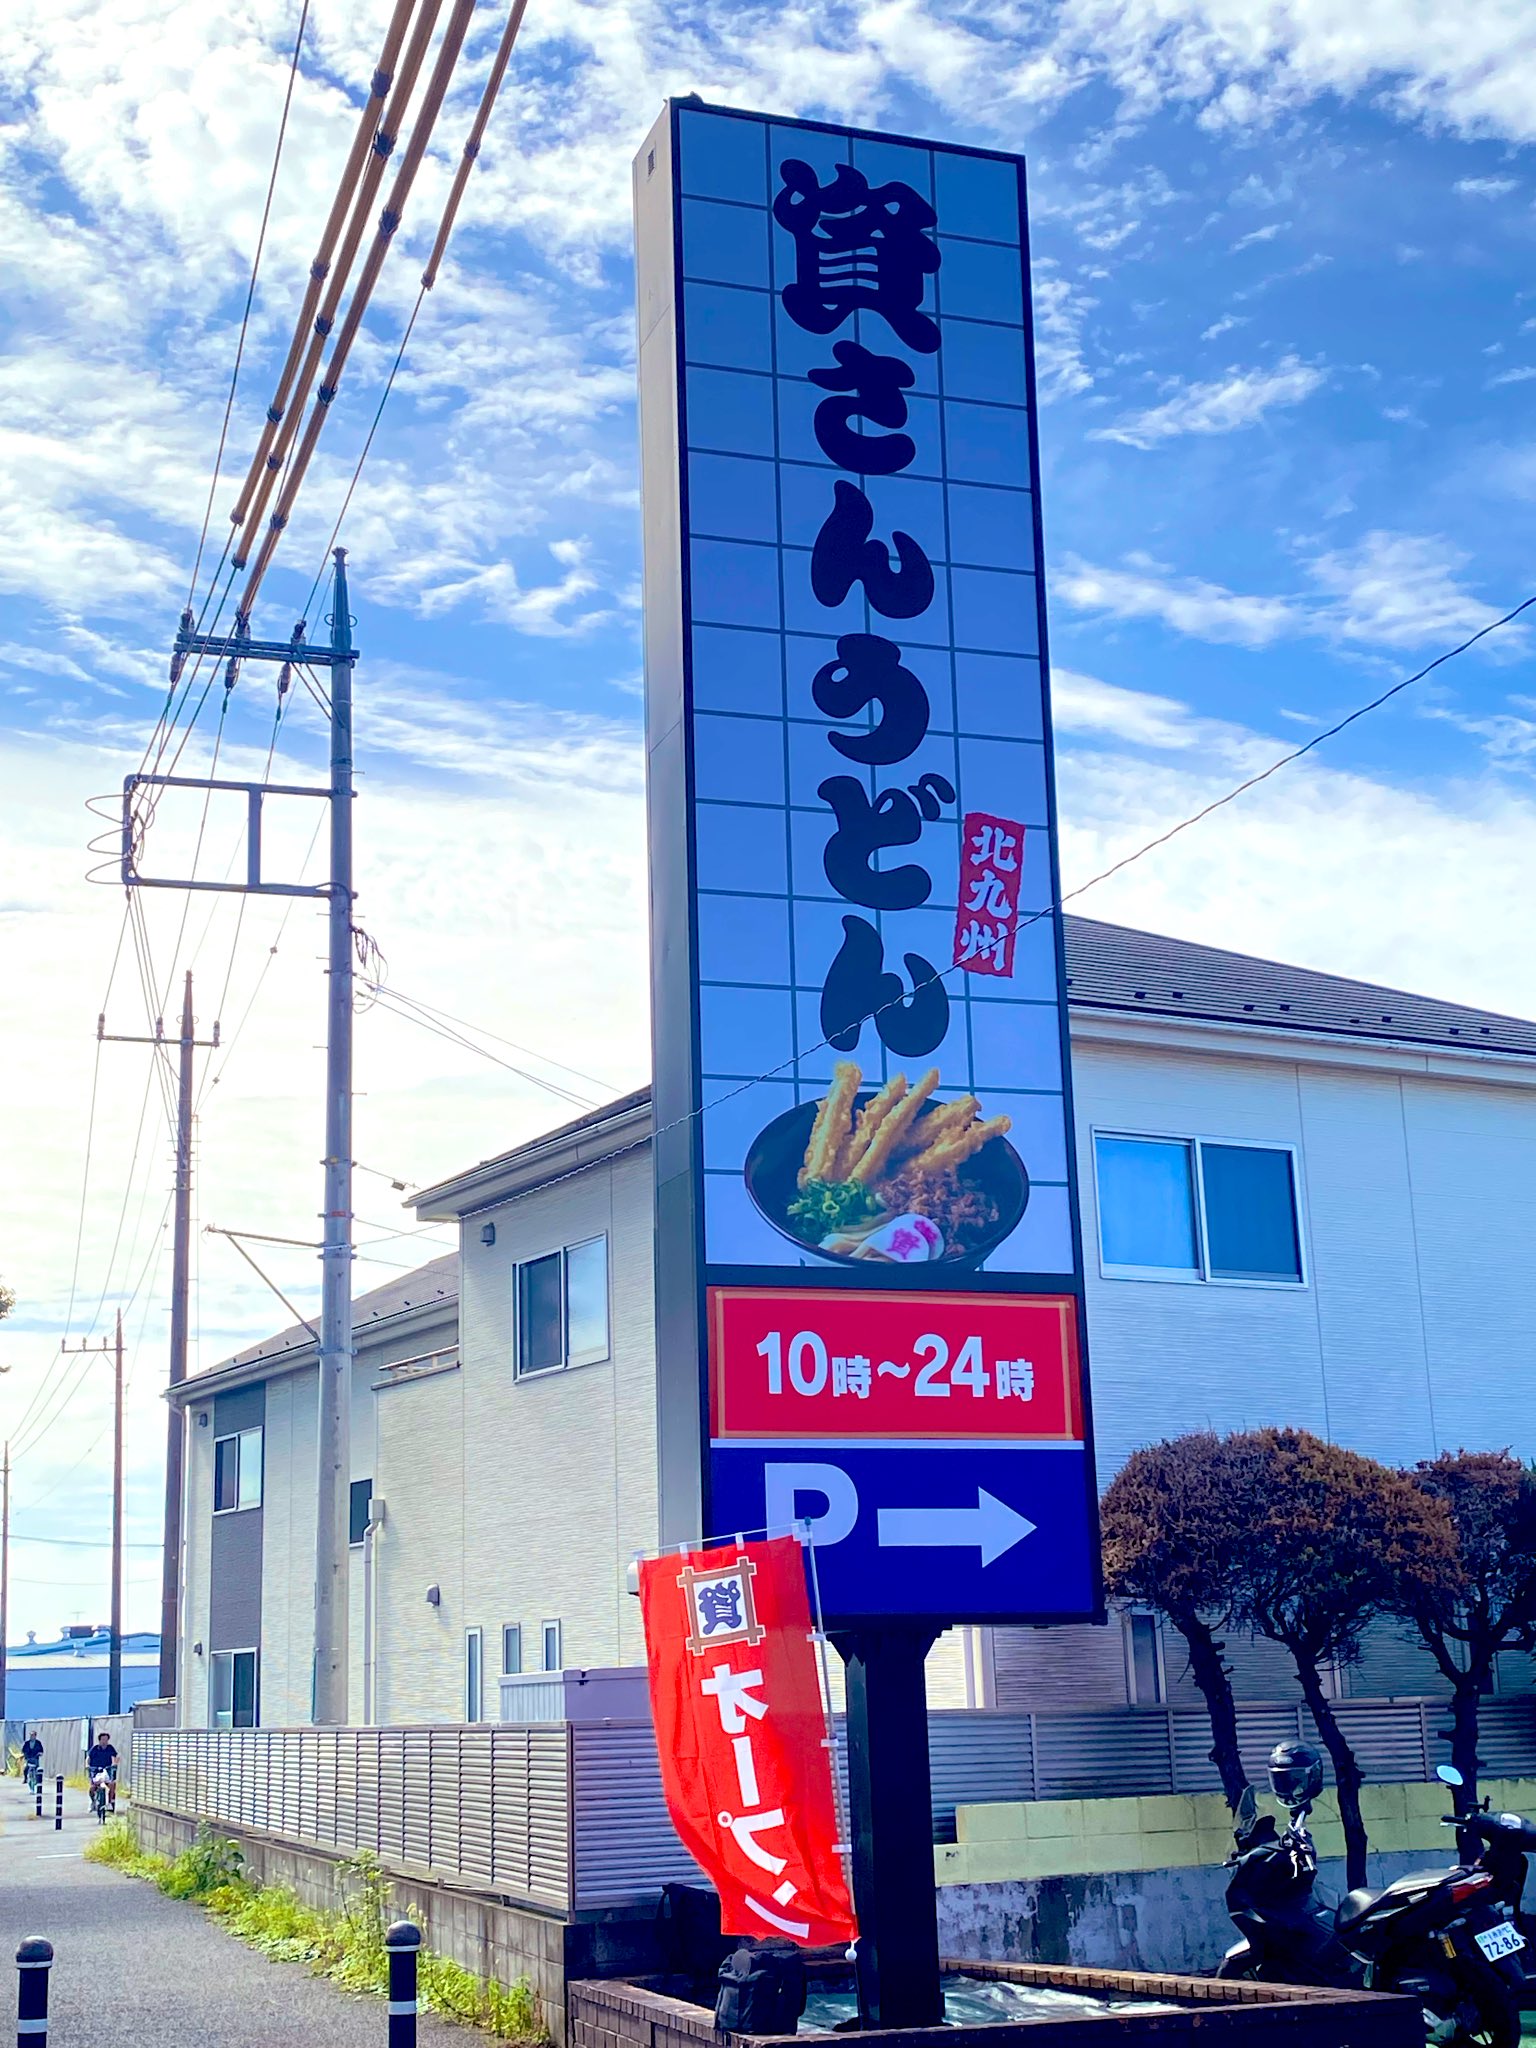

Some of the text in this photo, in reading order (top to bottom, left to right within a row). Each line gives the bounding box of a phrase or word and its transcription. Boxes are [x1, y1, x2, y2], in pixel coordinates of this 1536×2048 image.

[772, 158, 956, 1057] 資さんうどん
[958, 825, 1018, 971] 北九州
[765, 1463, 858, 1547] P
[1484, 1933, 1520, 1958] 72-86
